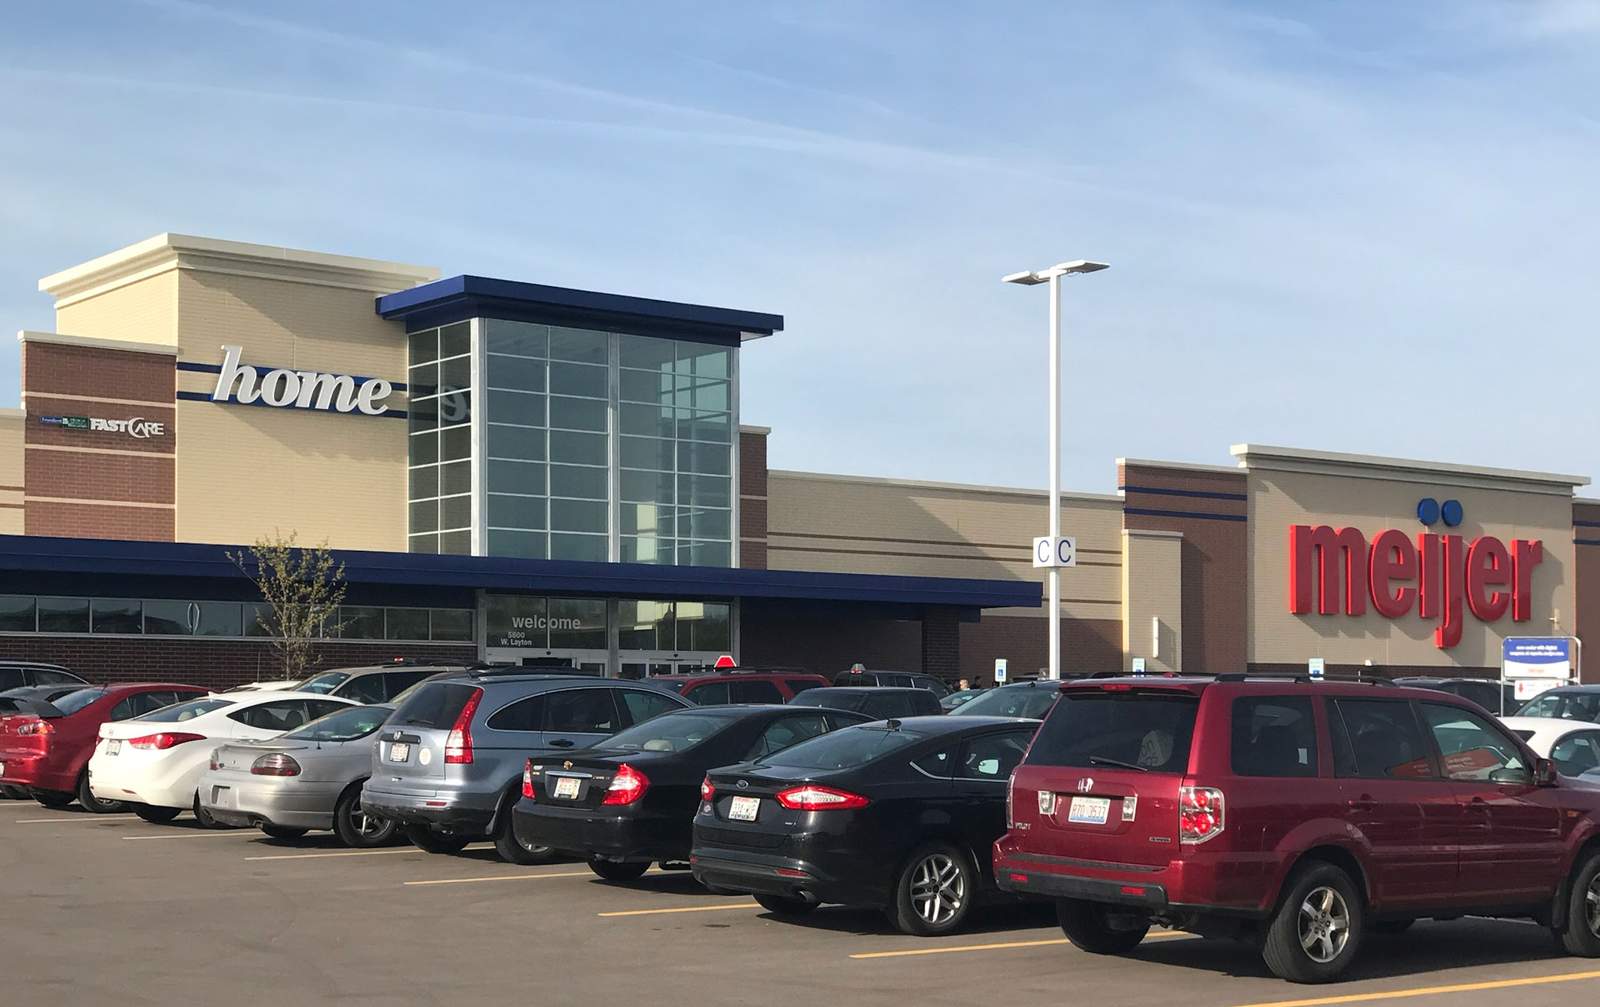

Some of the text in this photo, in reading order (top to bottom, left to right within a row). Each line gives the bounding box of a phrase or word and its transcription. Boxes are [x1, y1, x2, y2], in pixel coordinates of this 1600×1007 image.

[213, 344, 392, 415] home
[1037, 539, 1050, 563] C
[1058, 539, 1072, 564] C
[1289, 498, 1543, 650] meijer
[512, 615, 581, 629] welcome
